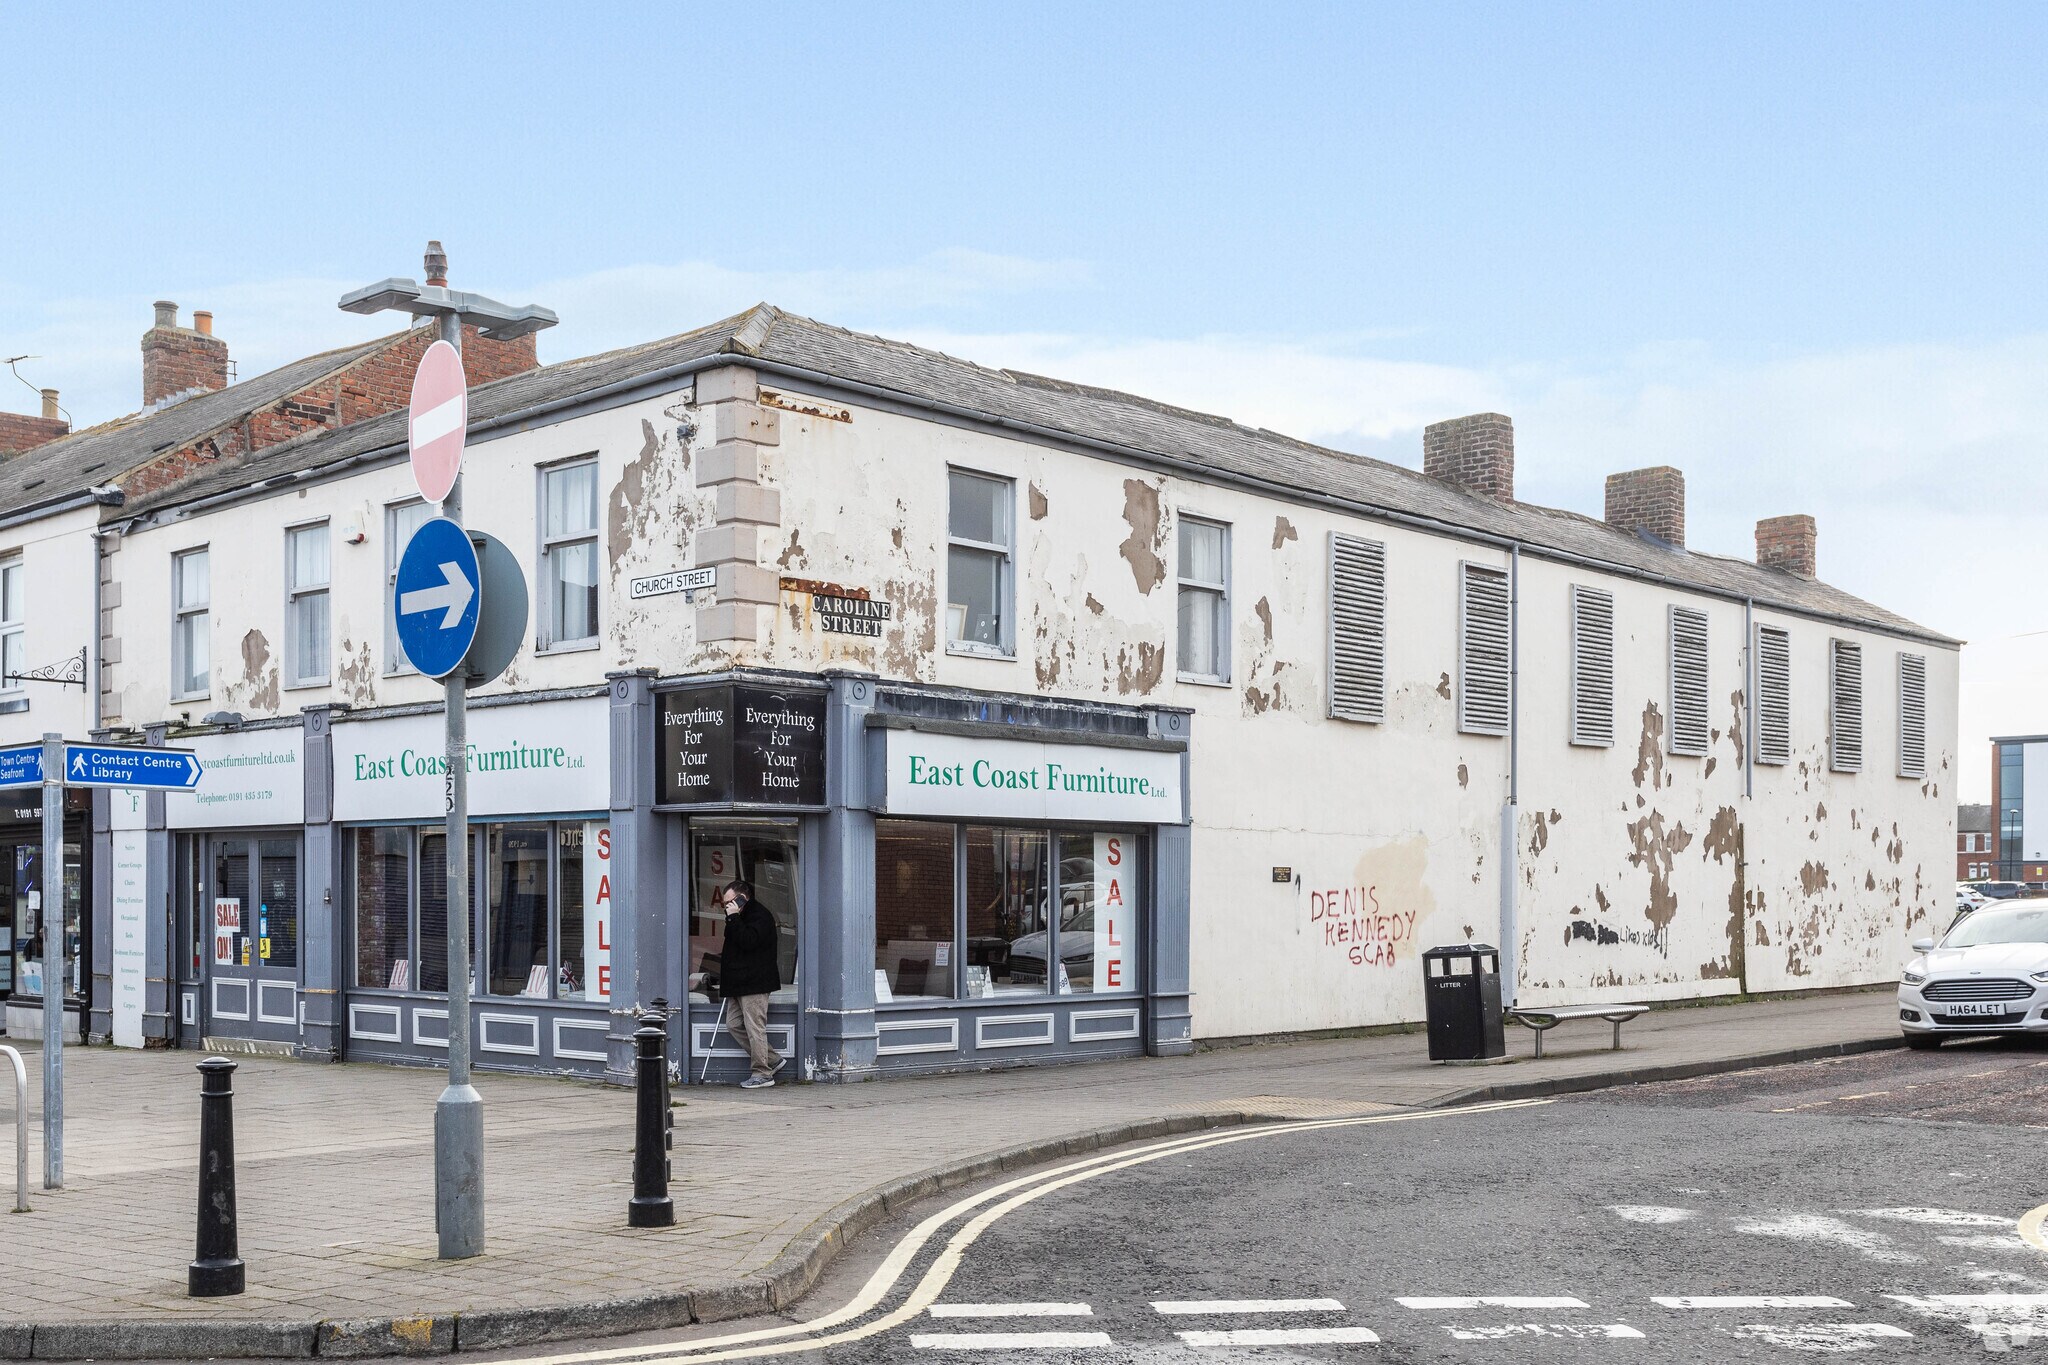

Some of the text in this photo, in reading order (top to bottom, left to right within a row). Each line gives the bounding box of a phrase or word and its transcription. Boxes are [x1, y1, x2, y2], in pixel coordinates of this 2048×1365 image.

[635, 570, 712, 594] CHURCH STREET
[812, 595, 890, 619] CAROLINE
[822, 614, 881, 636] STREET
[664, 706, 724, 728] Everything
[745, 707, 815, 731] Everything
[684, 730, 703, 745] For
[770, 730, 792, 746] For
[0, 755, 36, 767] Town Centre
[92, 753, 182, 769] Contact Centre
[200, 749, 296, 770] stcoastfurnitureltd.co.uk
[354, 740, 586, 781] East Coas Furniture Ltd.
[680, 751, 708, 766] Your
[765, 750, 798, 767] Your
[0, 767, 25, 780] Seafront
[92, 766, 133, 781] Library
[677, 772, 710, 787] Home
[761, 771, 800, 788] Home
[908, 755, 1168, 799] East Coast Furniture Ltd.
[196, 792, 228, 806] Telephone:
[228, 791, 243, 801] 0191
[1106, 837, 1123, 987] SALE
[1311, 886, 1379, 922] DENIS
[217, 904, 239, 927] SALE
[1325, 910, 1416, 946] KENNEDY
[217, 936, 232, 960] ON!
[1349, 942, 1396, 967] SCAB
[1950, 1004, 2000, 1014] HA64 LET
